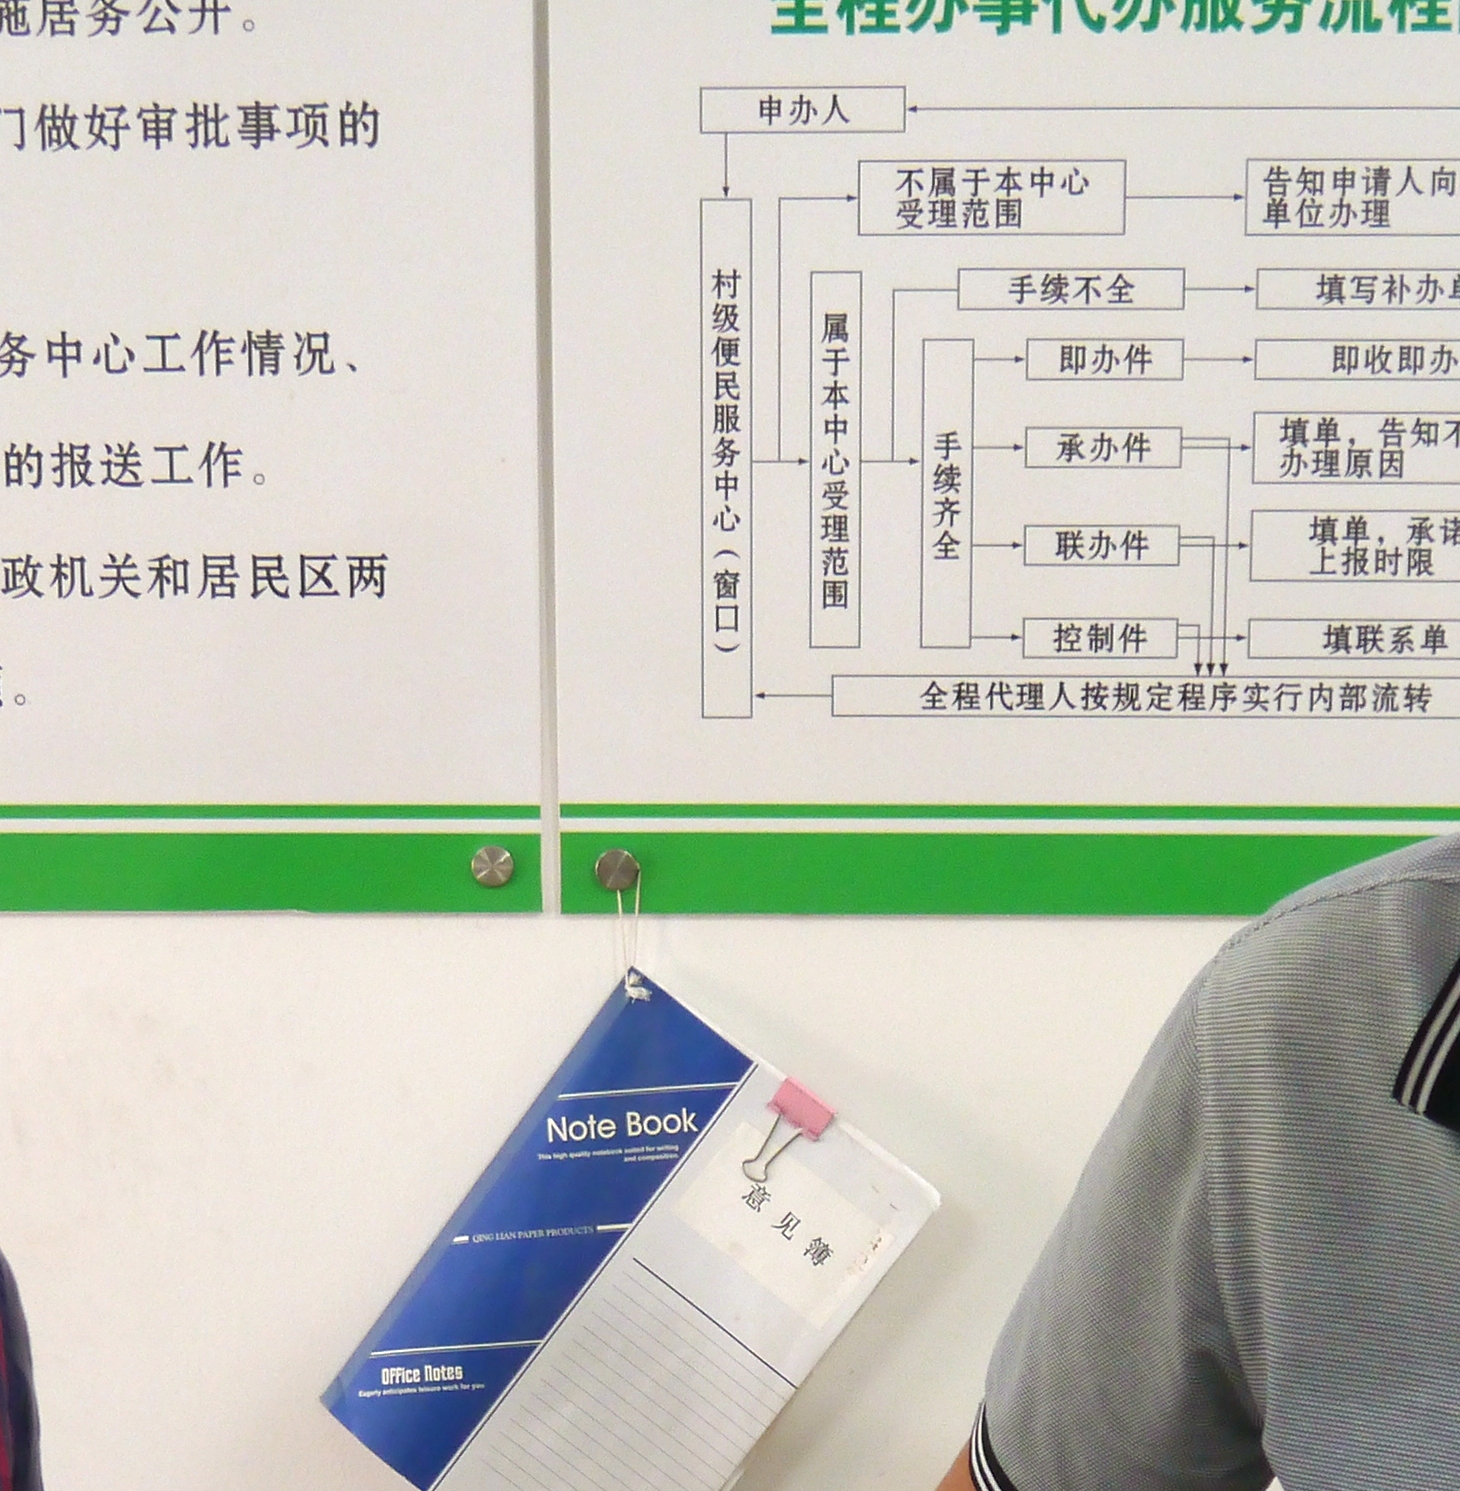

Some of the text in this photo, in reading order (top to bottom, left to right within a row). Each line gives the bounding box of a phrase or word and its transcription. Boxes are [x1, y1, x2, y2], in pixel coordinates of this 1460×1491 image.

[756, 95, 852, 127] 申办人
[895, 168, 1091, 198] 不属于本中心
[895, 199, 1024, 231] 受理范围
[1261, 199, 1391, 230] 单位办理
[1007, 274, 1136, 305] 手续不全
[1059, 345, 1153, 376] 即办件
[1331, 344, 1460, 375] 即收即办
[820, 312, 850, 610] 属于本中心受理范围
[1056, 432, 1152, 463] 承办件
[1279, 449, 1405, 479] 办理原因
[932, 431, 963, 563] 手续齐全
[1055, 529, 1150, 560] 联办件
[1309, 547, 1435, 577] 上报时限
[1053, 623, 1148, 655] 控制件
[1323, 624, 1450, 655] 填联系单
[920, 681, 1434, 713] 全程代理人按规定程序实行内部流转
[547, 1107, 699, 1143] Note Book
[473, 1226, 594, 1243] QING LIAN PAPER PRODUCTS
